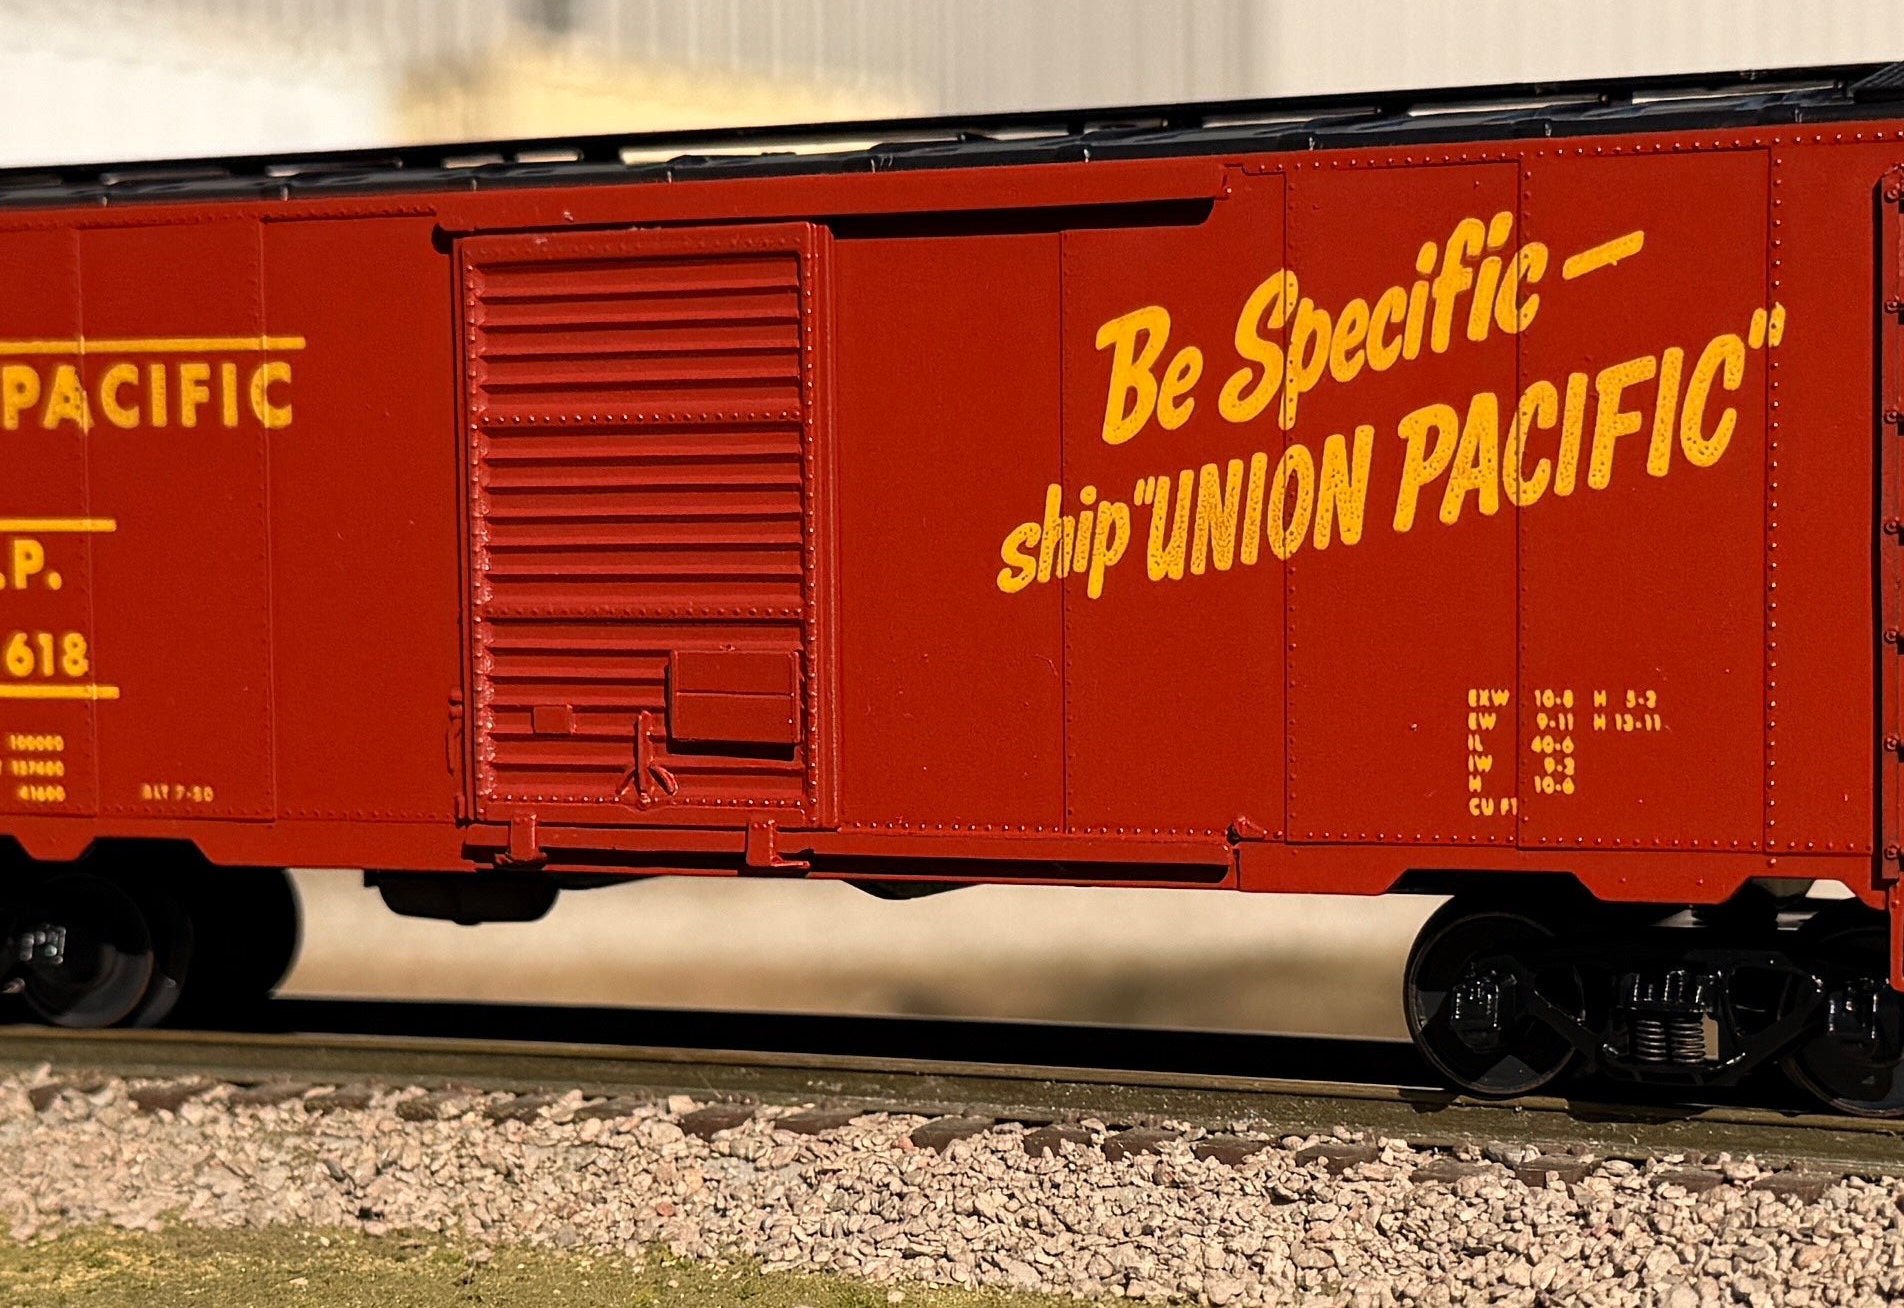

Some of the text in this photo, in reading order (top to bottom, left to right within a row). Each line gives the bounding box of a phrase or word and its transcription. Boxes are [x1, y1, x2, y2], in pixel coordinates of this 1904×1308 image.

[1096, 306, 1203, 445] Be
[1216, 211, 1549, 431] Specific
[0, 361, 294, 434] PACIFIC
[997, 483, 1130, 599] ship
[1467, 689, 1510, 708] EXW
[1593, 689, 1607, 708] H
[1467, 712, 1497, 731] EW
[1593, 713, 1607, 731] H
[1467, 734, 1484, 752] IL
[1467, 754, 1493, 773] IW
[1468, 775, 1482, 793] H
[1468, 797, 1518, 817] CU FT
